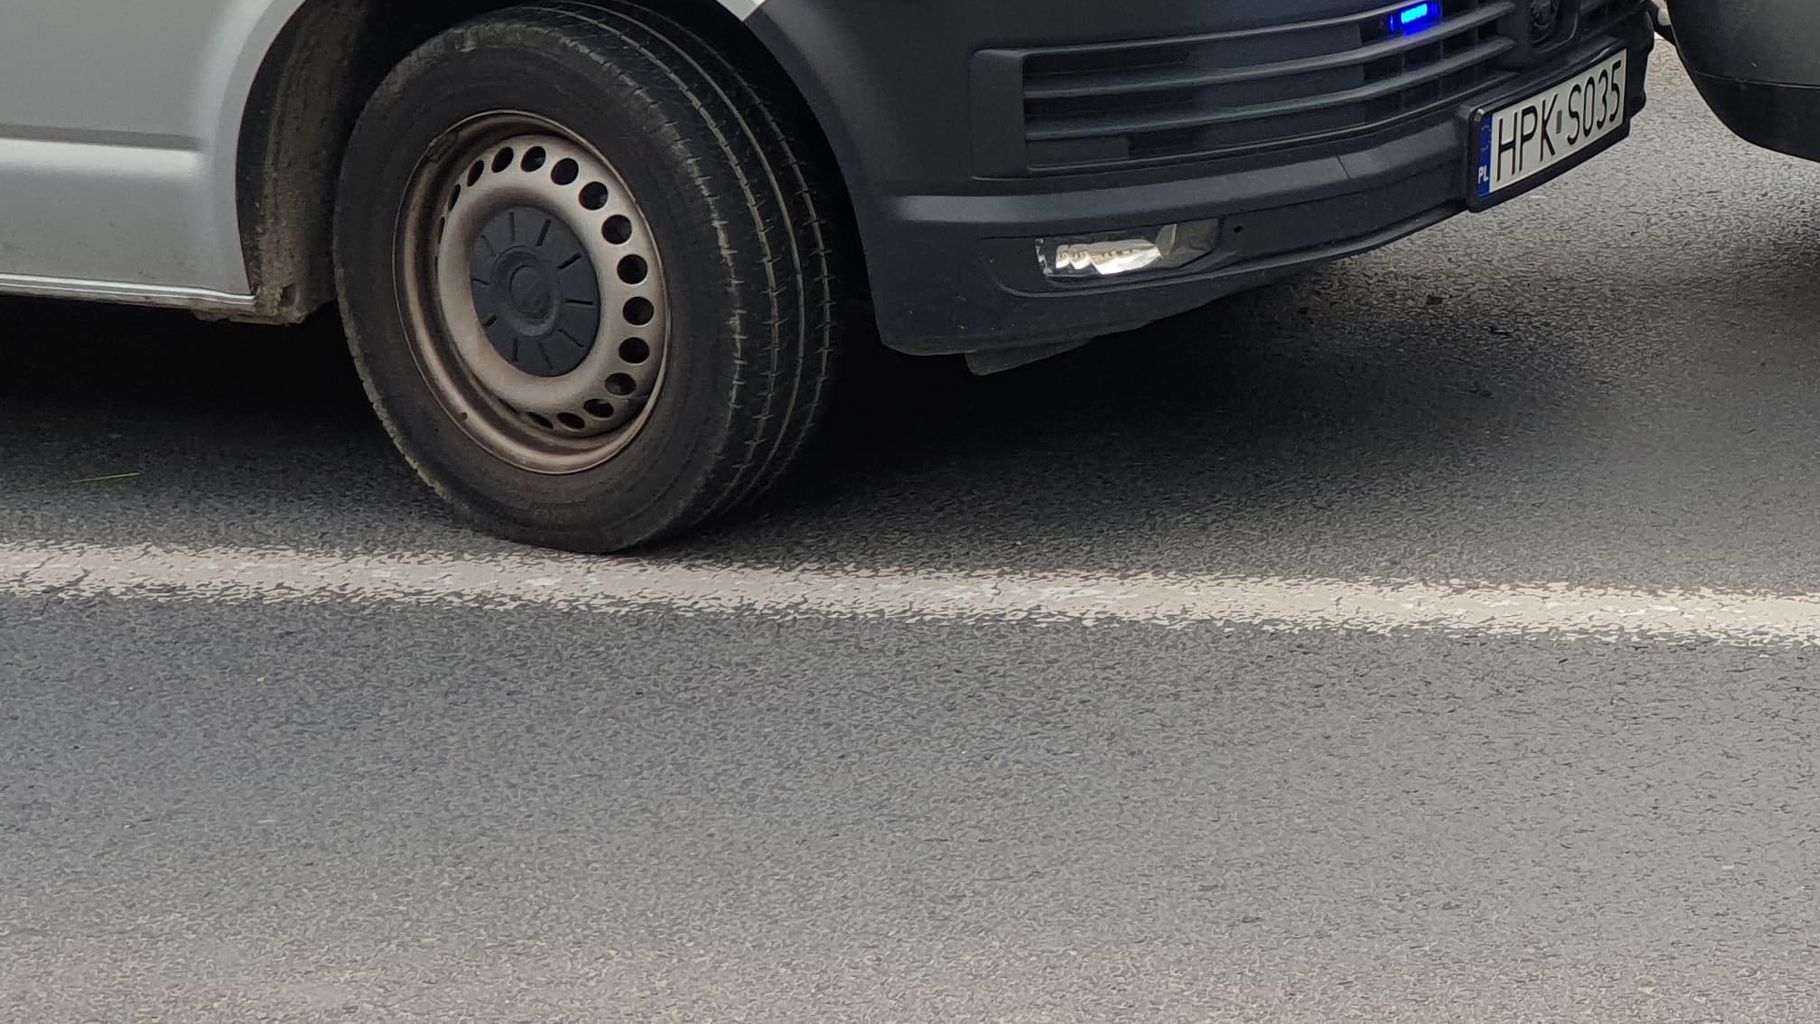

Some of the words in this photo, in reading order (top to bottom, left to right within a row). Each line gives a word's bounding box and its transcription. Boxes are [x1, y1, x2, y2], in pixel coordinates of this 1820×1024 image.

[1496, 93, 1559, 182] HPK
[1567, 59, 1622, 146] S035
[1478, 165, 1489, 184] PL
